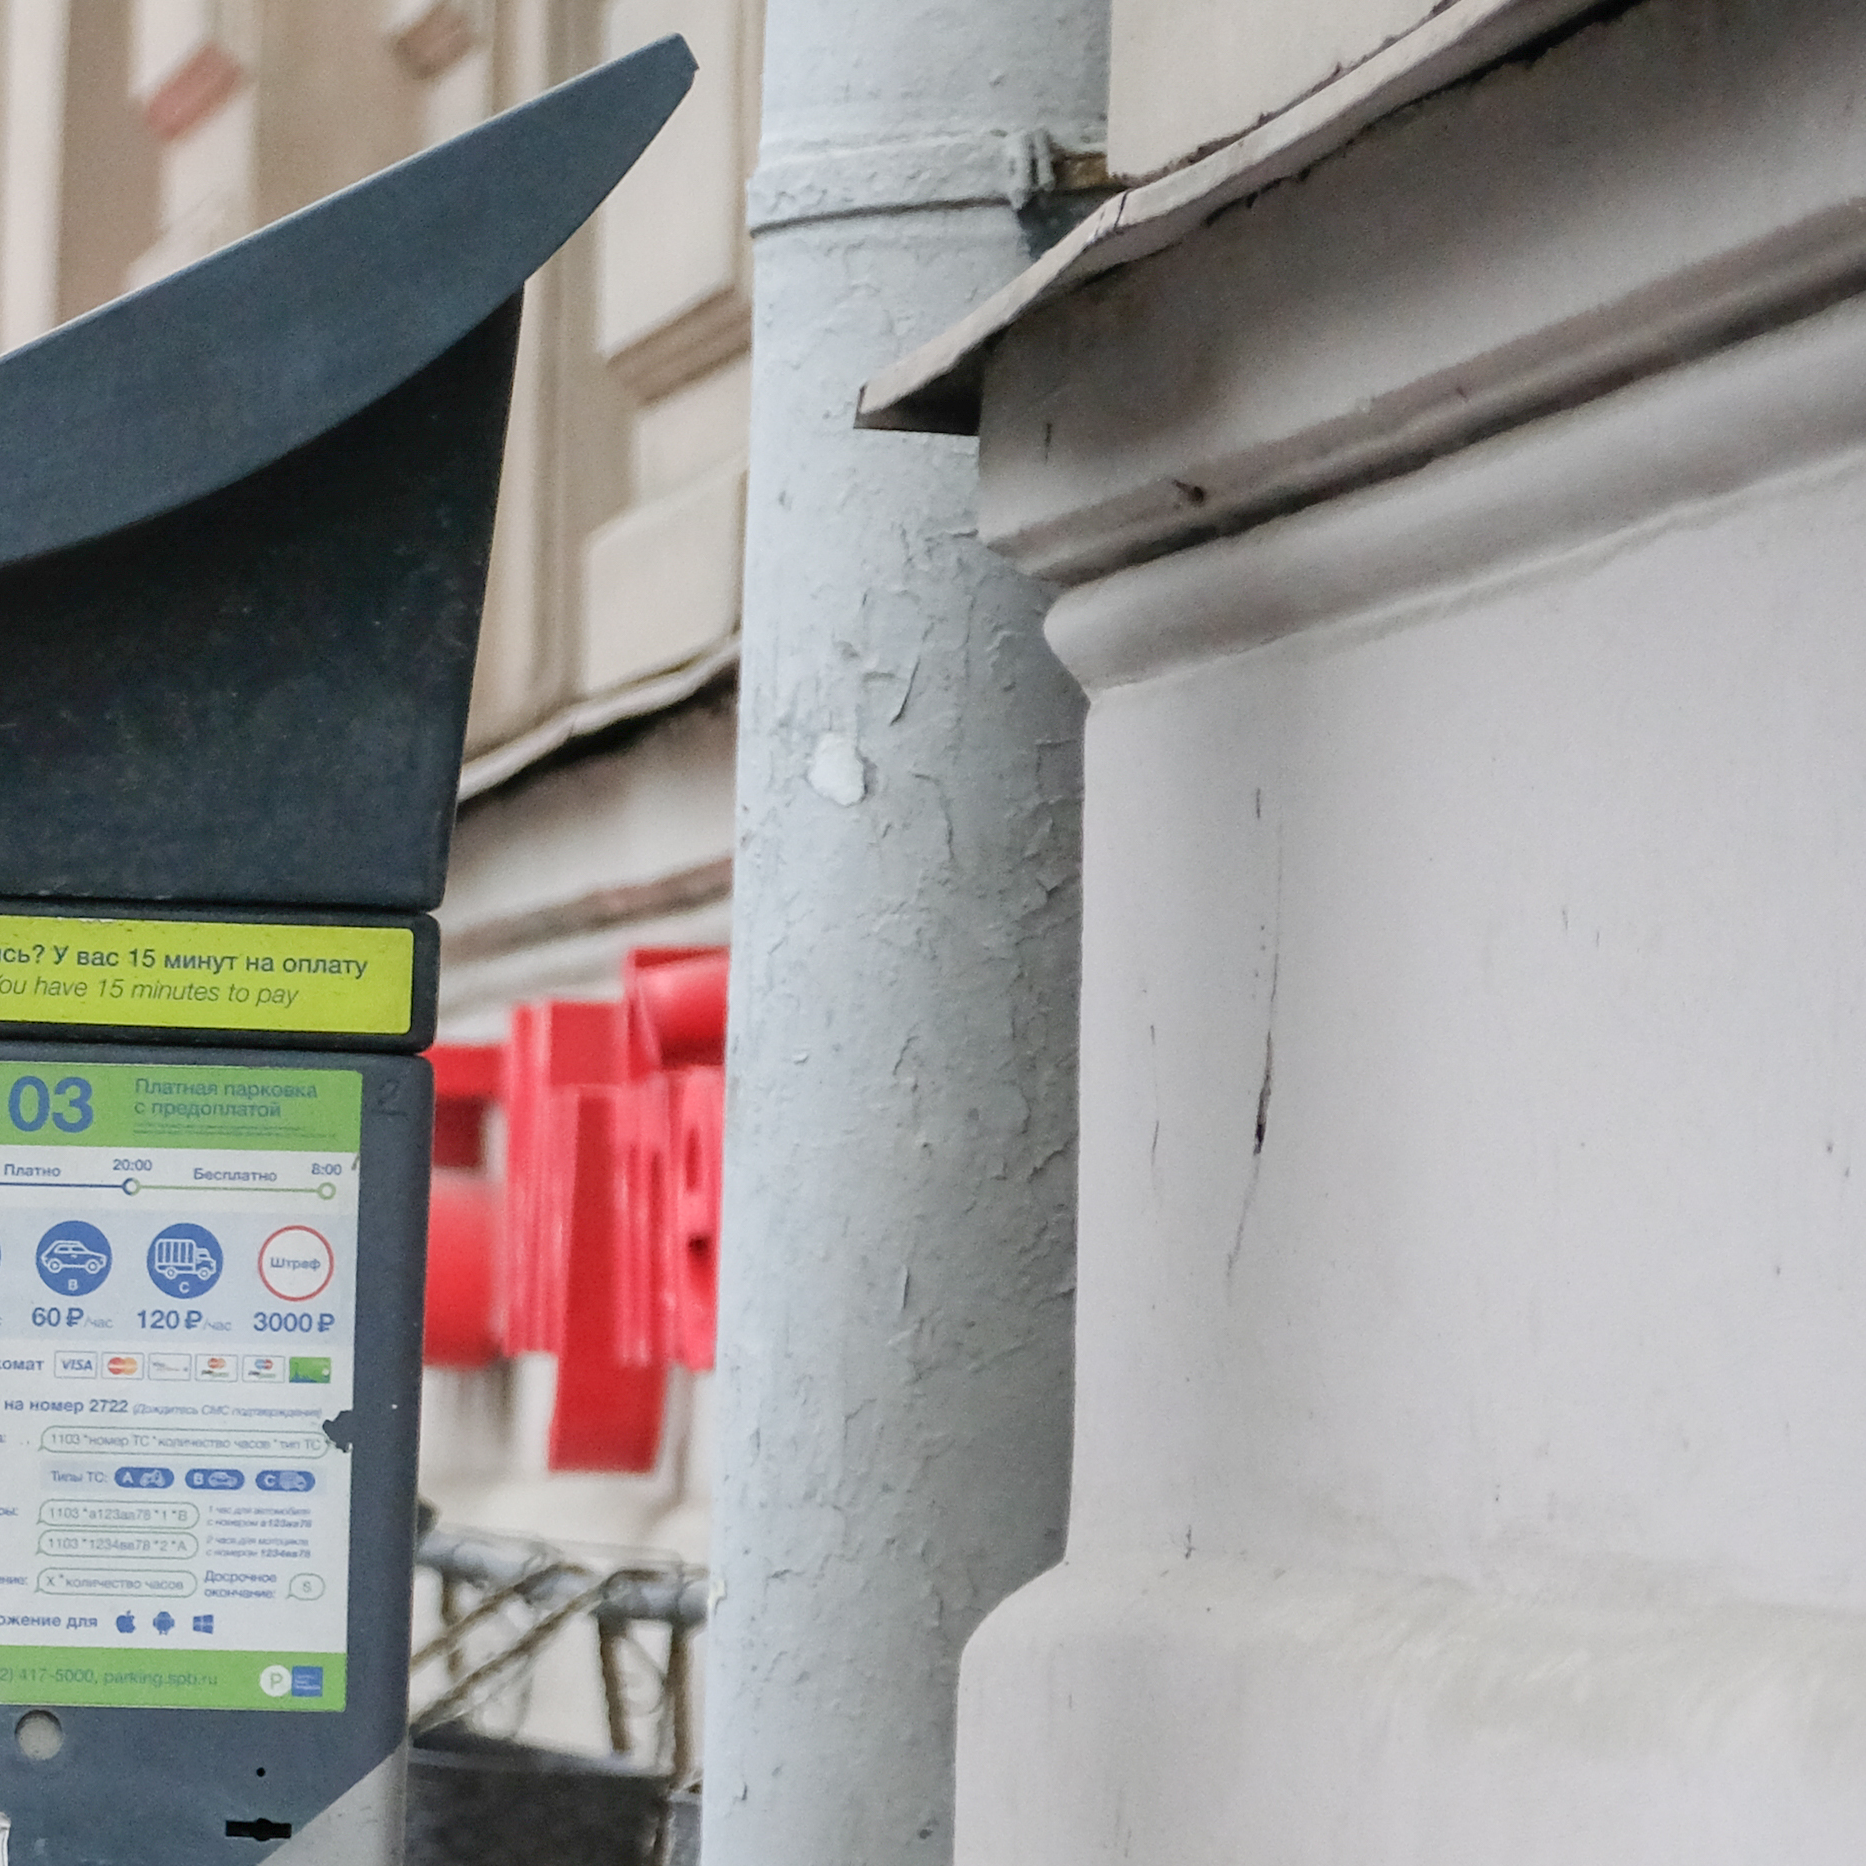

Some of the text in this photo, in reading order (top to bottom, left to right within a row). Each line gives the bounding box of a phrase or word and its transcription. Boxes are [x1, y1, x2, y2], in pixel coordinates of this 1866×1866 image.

[53, 945, 69, 965] У
[77, 951, 119, 967] вас
[129, 949, 156, 968] 15
[164, 953, 237, 974] минут
[246, 956, 274, 972] на
[282, 958, 367, 980] оплату
[34, 976, 87, 997] have
[98, 979, 123, 998] 15
[131, 981, 220, 1001] minutes
[228, 985, 249, 1003] to
[256, 988, 299, 1008] pay
[135, 1077, 318, 1100] Платная парковка
[134, 1101, 281, 1119] с предоплатой
[4, 1163, 61, 1177] Платно
[113, 1158, 153, 1172] 20:00
[311, 1162, 342, 1176] 8:00
[193, 1167, 277, 1183] Бесплатно
[270, 1257, 321, 1272] Штраф
[67, 1279, 79, 1292] B
[31, 1307, 62, 1327] 60
[137, 1309, 180, 1330] 120
[253, 1311, 313, 1332] 3000
[62, 1359, 93, 1371] VISA
[4, 1400, 24, 1411] на
[29, 1401, 84, 1415] номер
[89, 1399, 129, 1413] 2722
[51, 1434, 81, 1445] 1103
[234, 1440, 272, 1450] часов
[50, 1507, 80, 1520] 1103
[48, 1537, 79, 1549] 1103
[145, 1579, 184, 1590] часов
[204, 1570, 277, 1584] Досрочное
[66, 1616, 98, 1630] для
